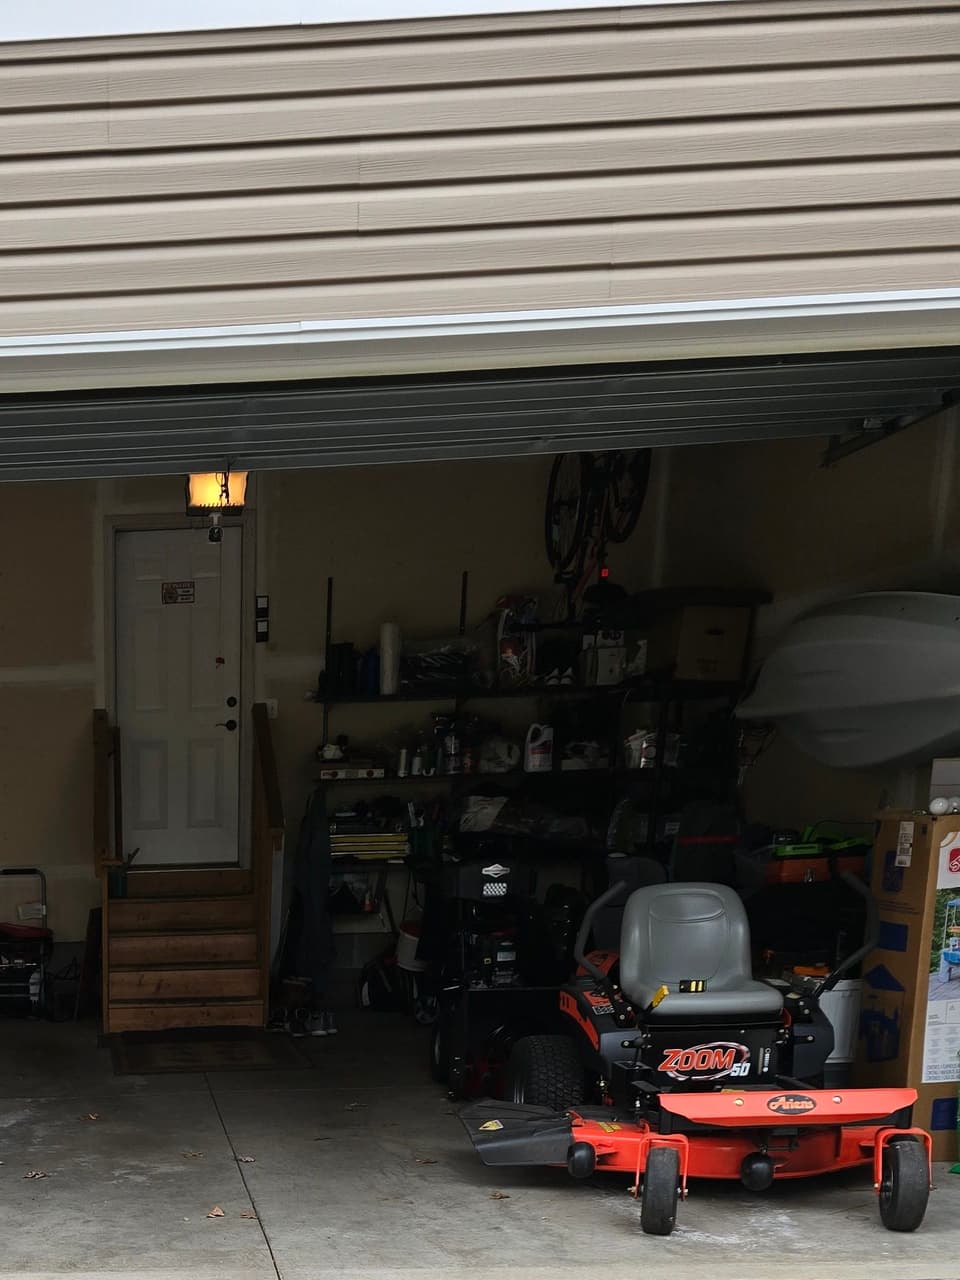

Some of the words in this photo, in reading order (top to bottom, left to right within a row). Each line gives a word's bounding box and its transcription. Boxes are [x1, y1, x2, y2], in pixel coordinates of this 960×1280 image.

[658, 1048, 737, 1072] ZOOM
[730, 1062, 751, 1077] 50
[770, 1096, 814, 1111] Ariens
